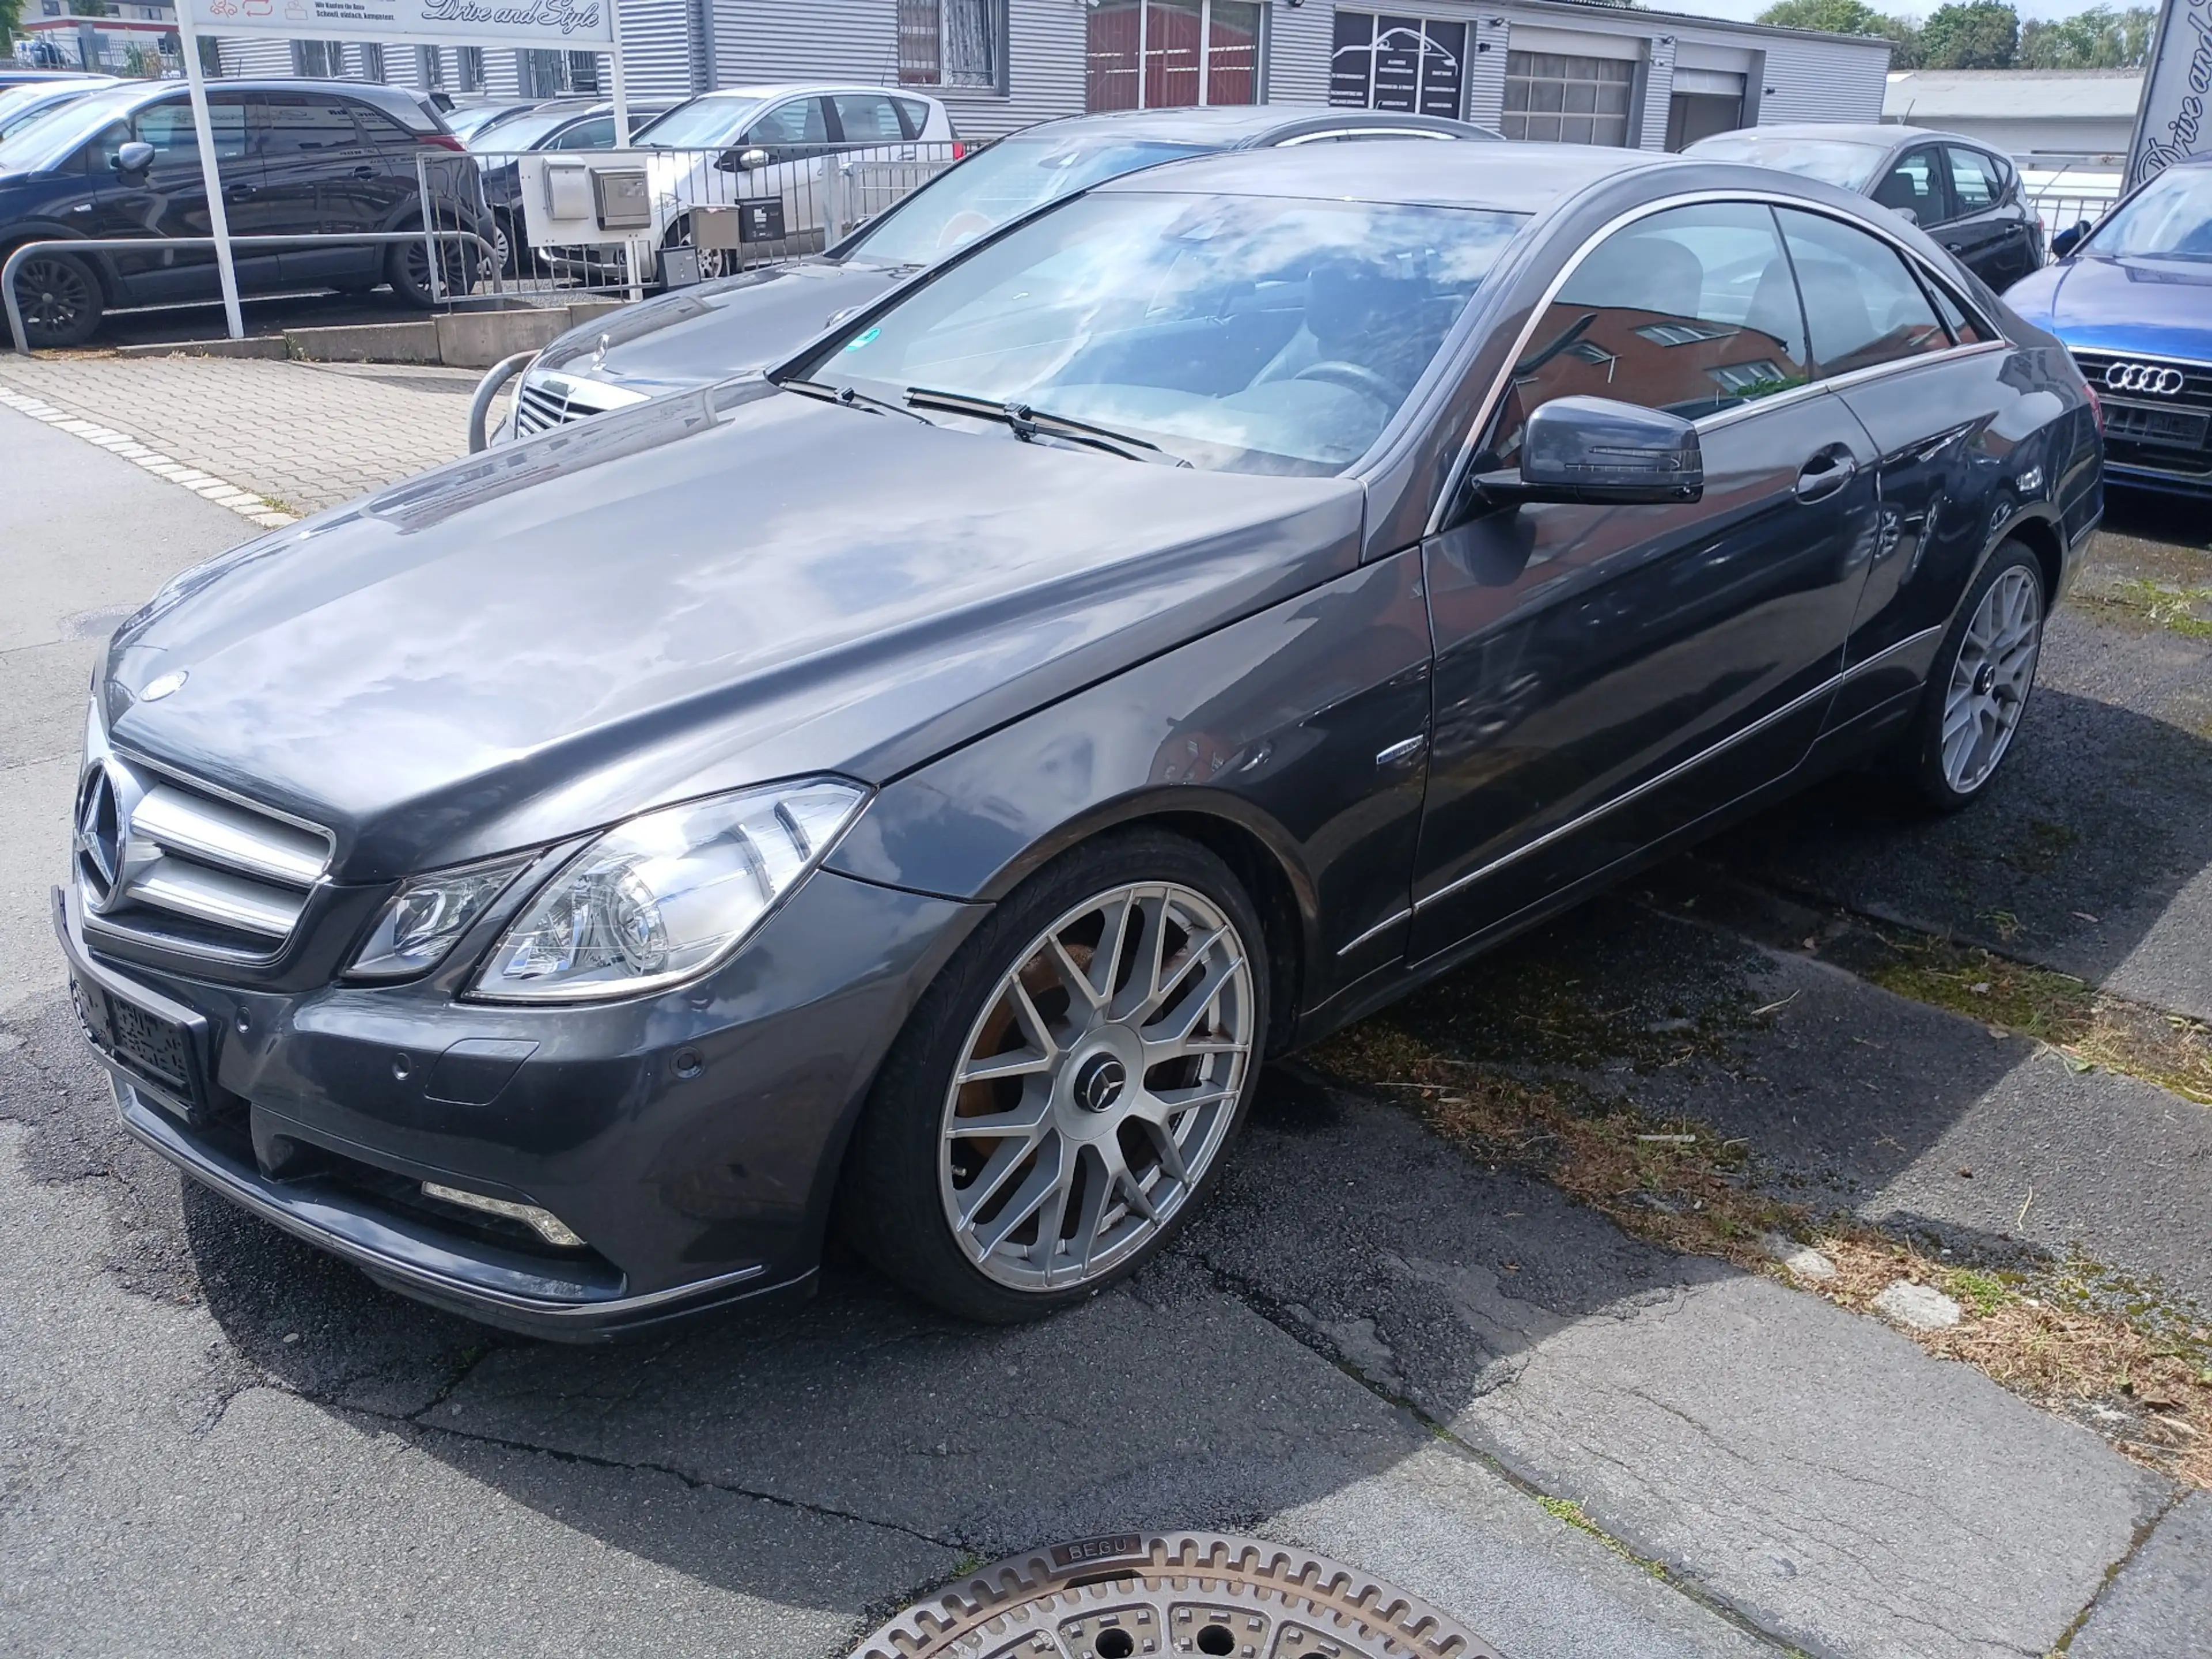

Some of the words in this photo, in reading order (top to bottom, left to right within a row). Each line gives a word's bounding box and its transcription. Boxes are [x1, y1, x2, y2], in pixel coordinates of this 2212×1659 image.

[421, 0, 491, 21] Drive
[494, 0, 541, 24] and
[537, 0, 599, 34] Style
[1069, 1539, 1127, 1558] BEGU
